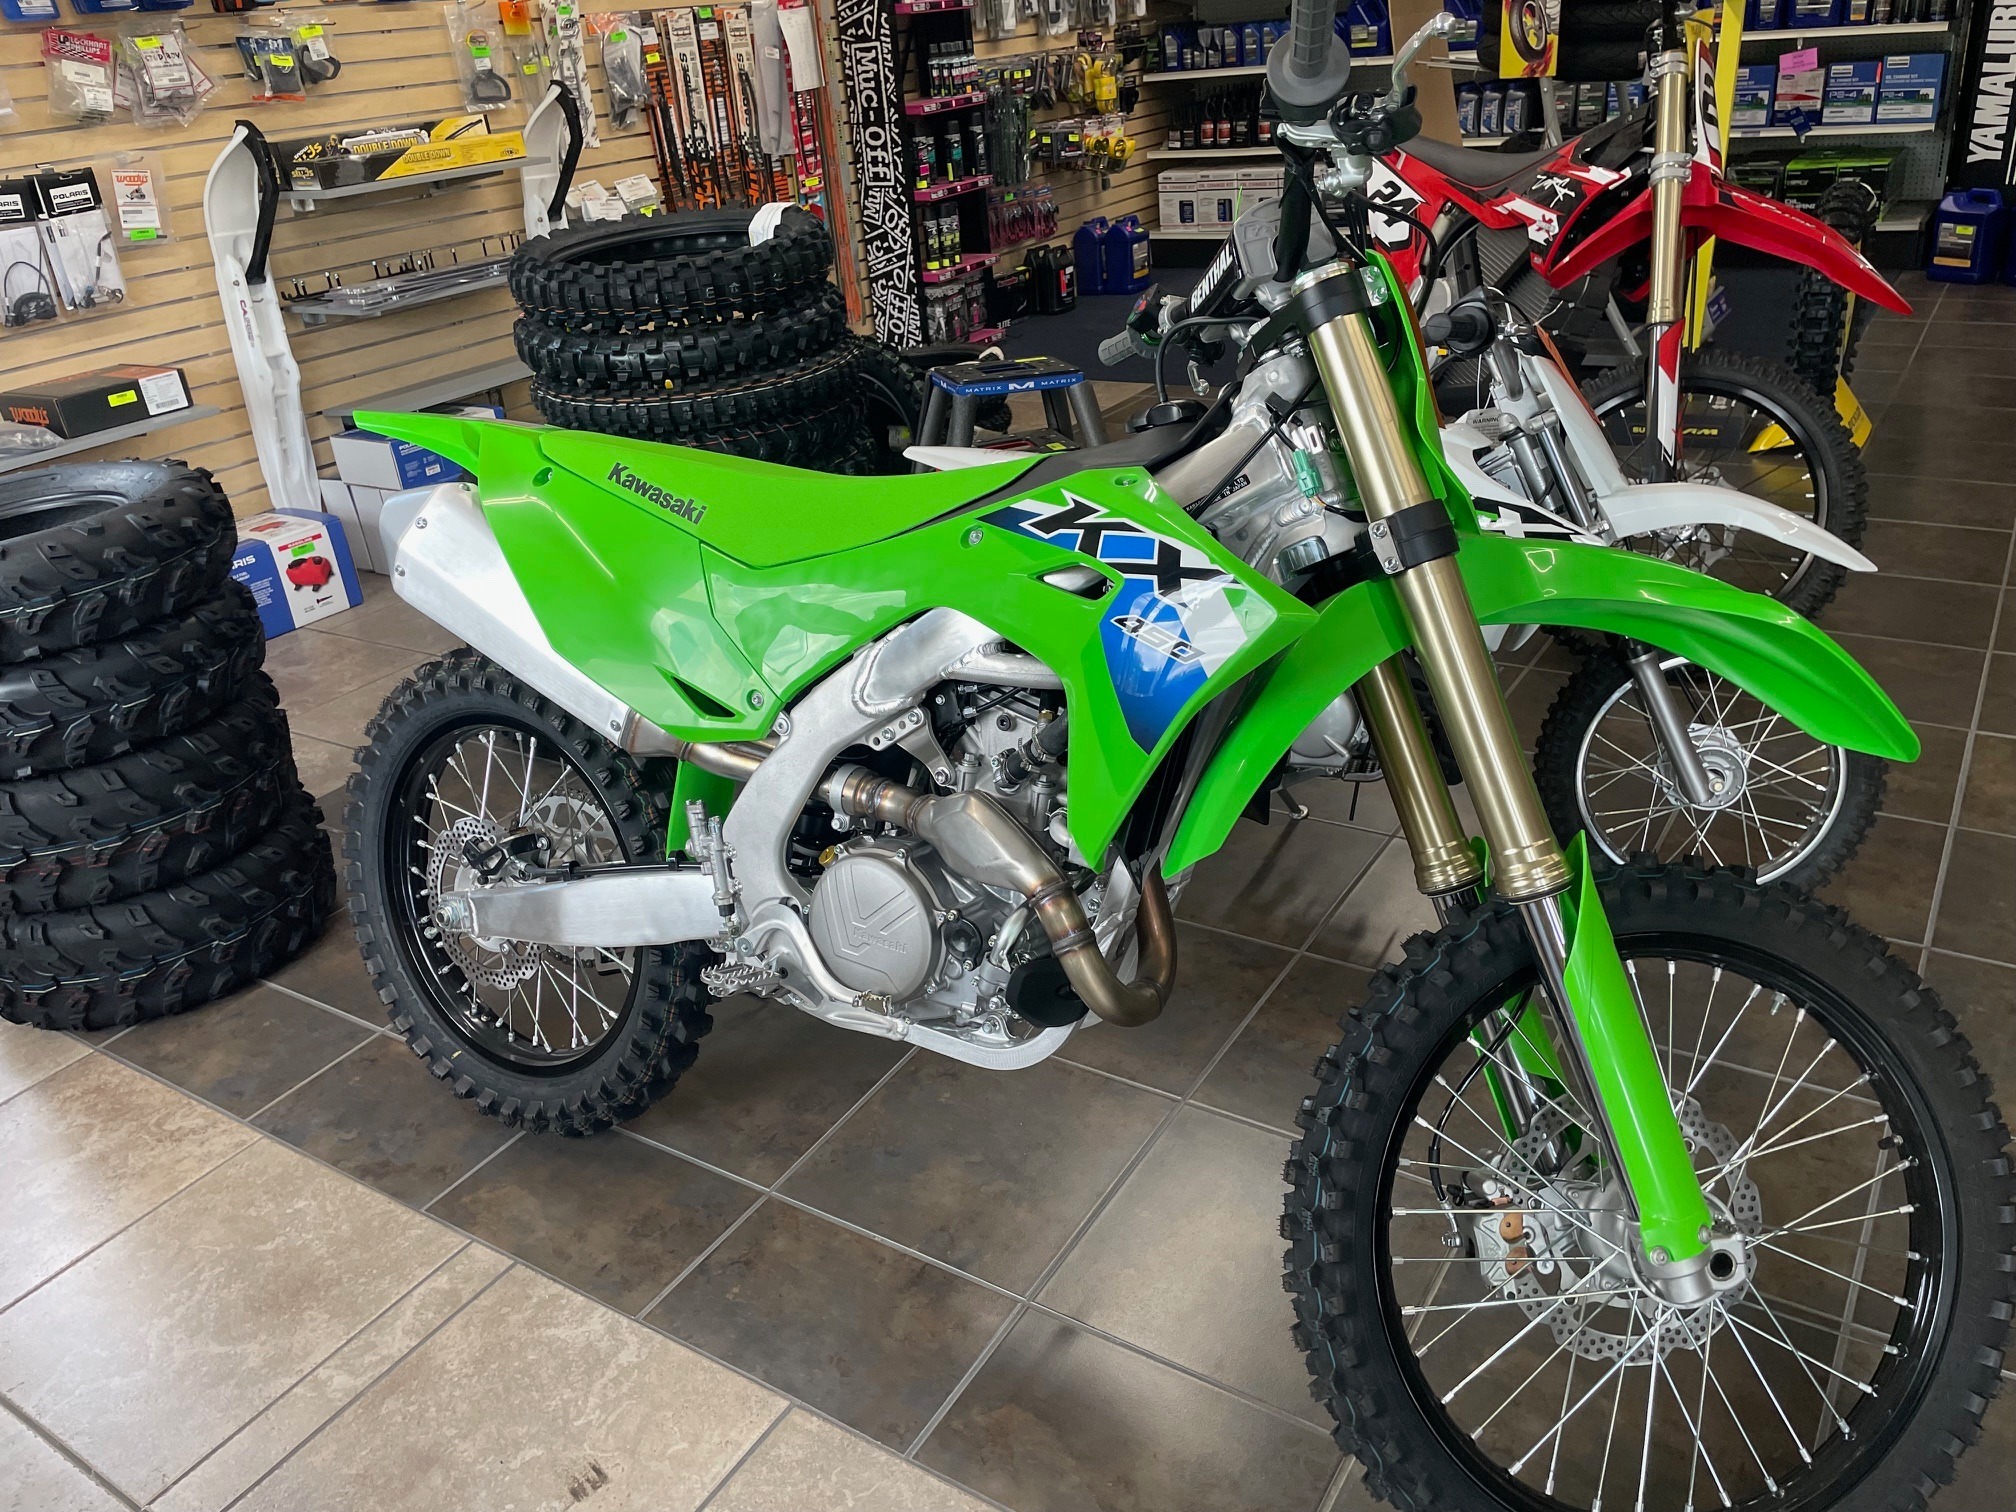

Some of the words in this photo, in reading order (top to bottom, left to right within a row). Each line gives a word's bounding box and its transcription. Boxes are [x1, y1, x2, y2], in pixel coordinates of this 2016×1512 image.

[70, 36, 108, 50] LOCKHART
[1967, 0, 2016, 163] YAMALUB
[855, 48, 892, 180] Muc-Off
[403, 152, 430, 164] DOUBLE
[430, 148, 452, 160] DOWN
[53, 189, 89, 200] POLARIS
[1190, 243, 1234, 313] RENTHAL
[965, 385, 1003, 394] MATRIX
[1040, 377, 1078, 387] MATRIX
[607, 461, 708, 525] Kawasaki
[1111, 614, 1206, 665] 450
[852, 926, 908, 955] Kawasaki
